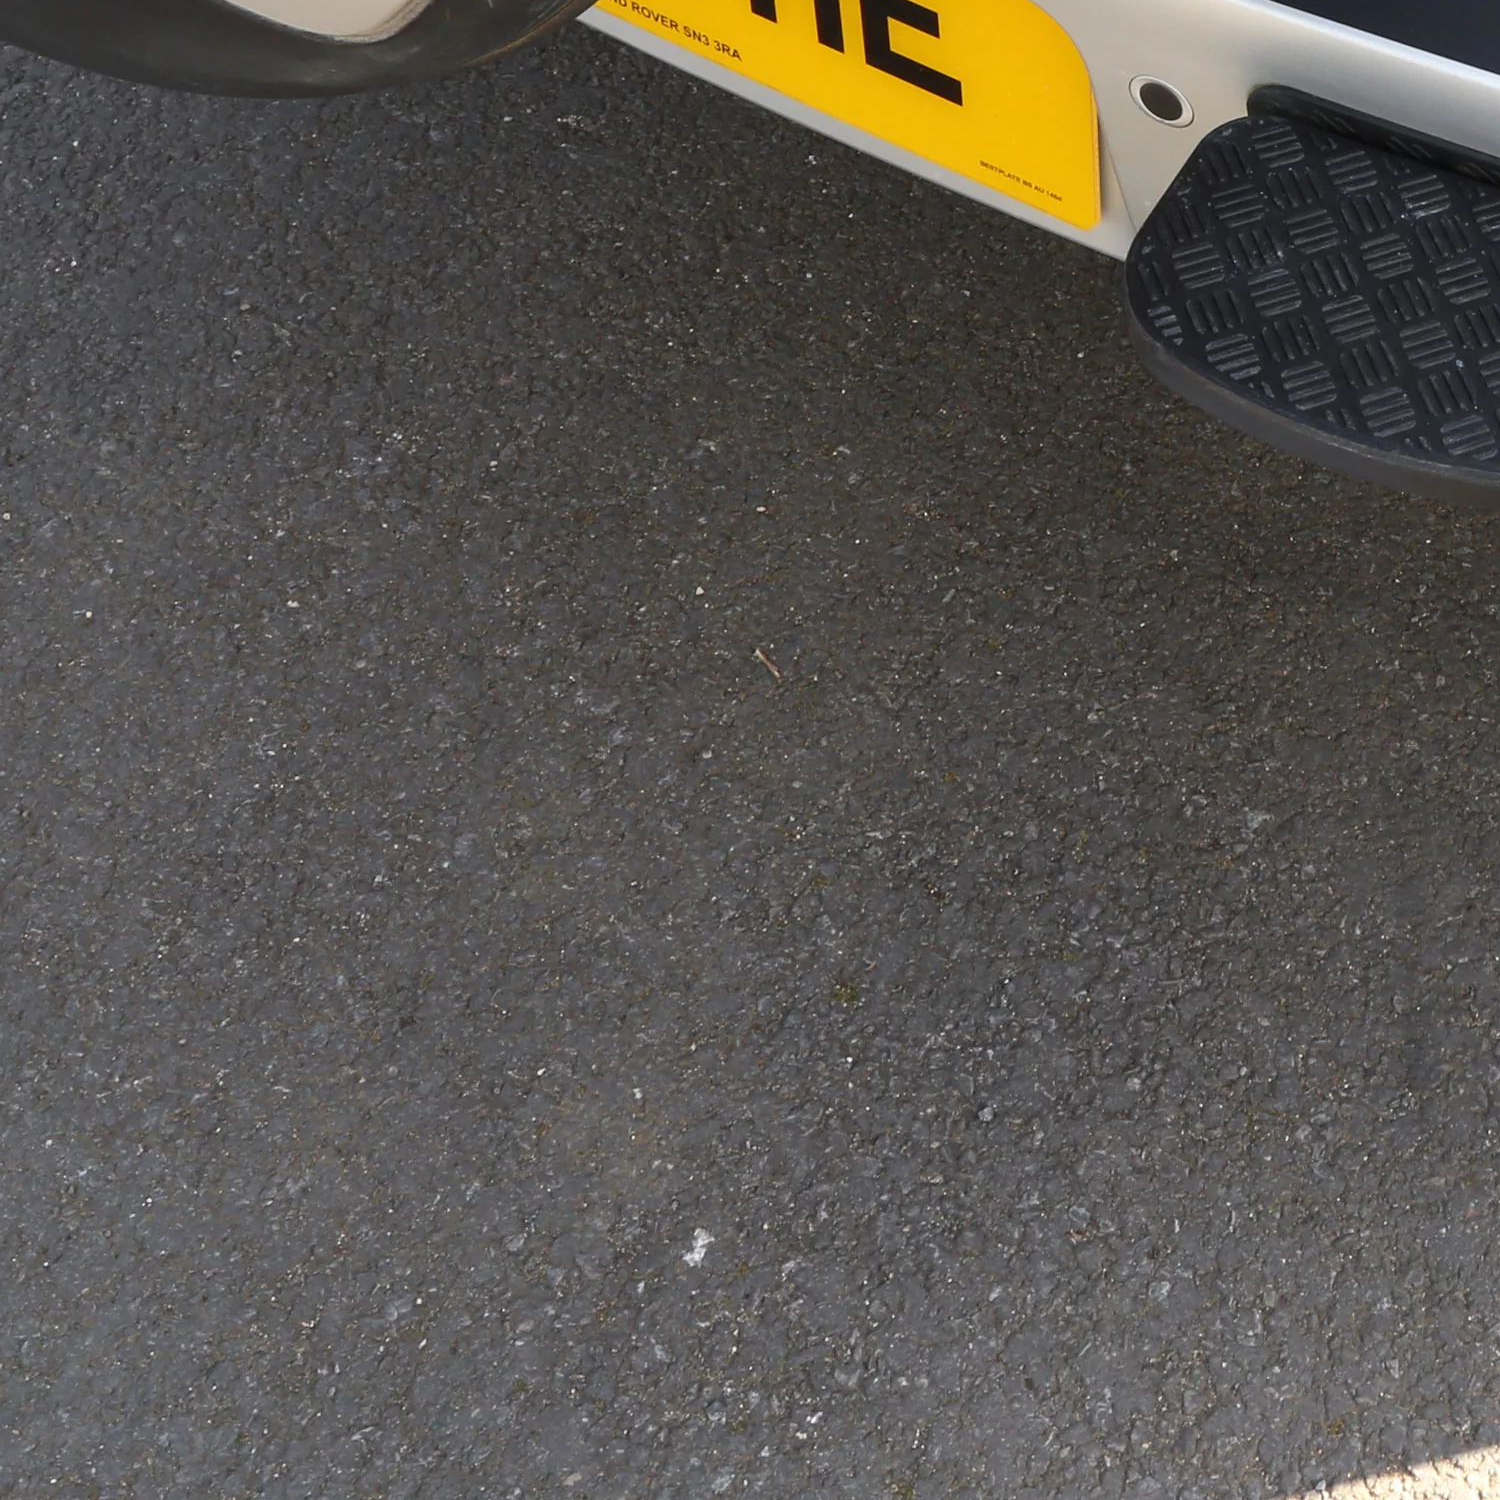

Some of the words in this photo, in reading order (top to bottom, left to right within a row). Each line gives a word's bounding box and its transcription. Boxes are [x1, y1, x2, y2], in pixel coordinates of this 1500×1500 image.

[631, 1, 680, 33] ROVER
[683, 26, 710, 46] SN3
[713, 39, 742, 62] 3RA
